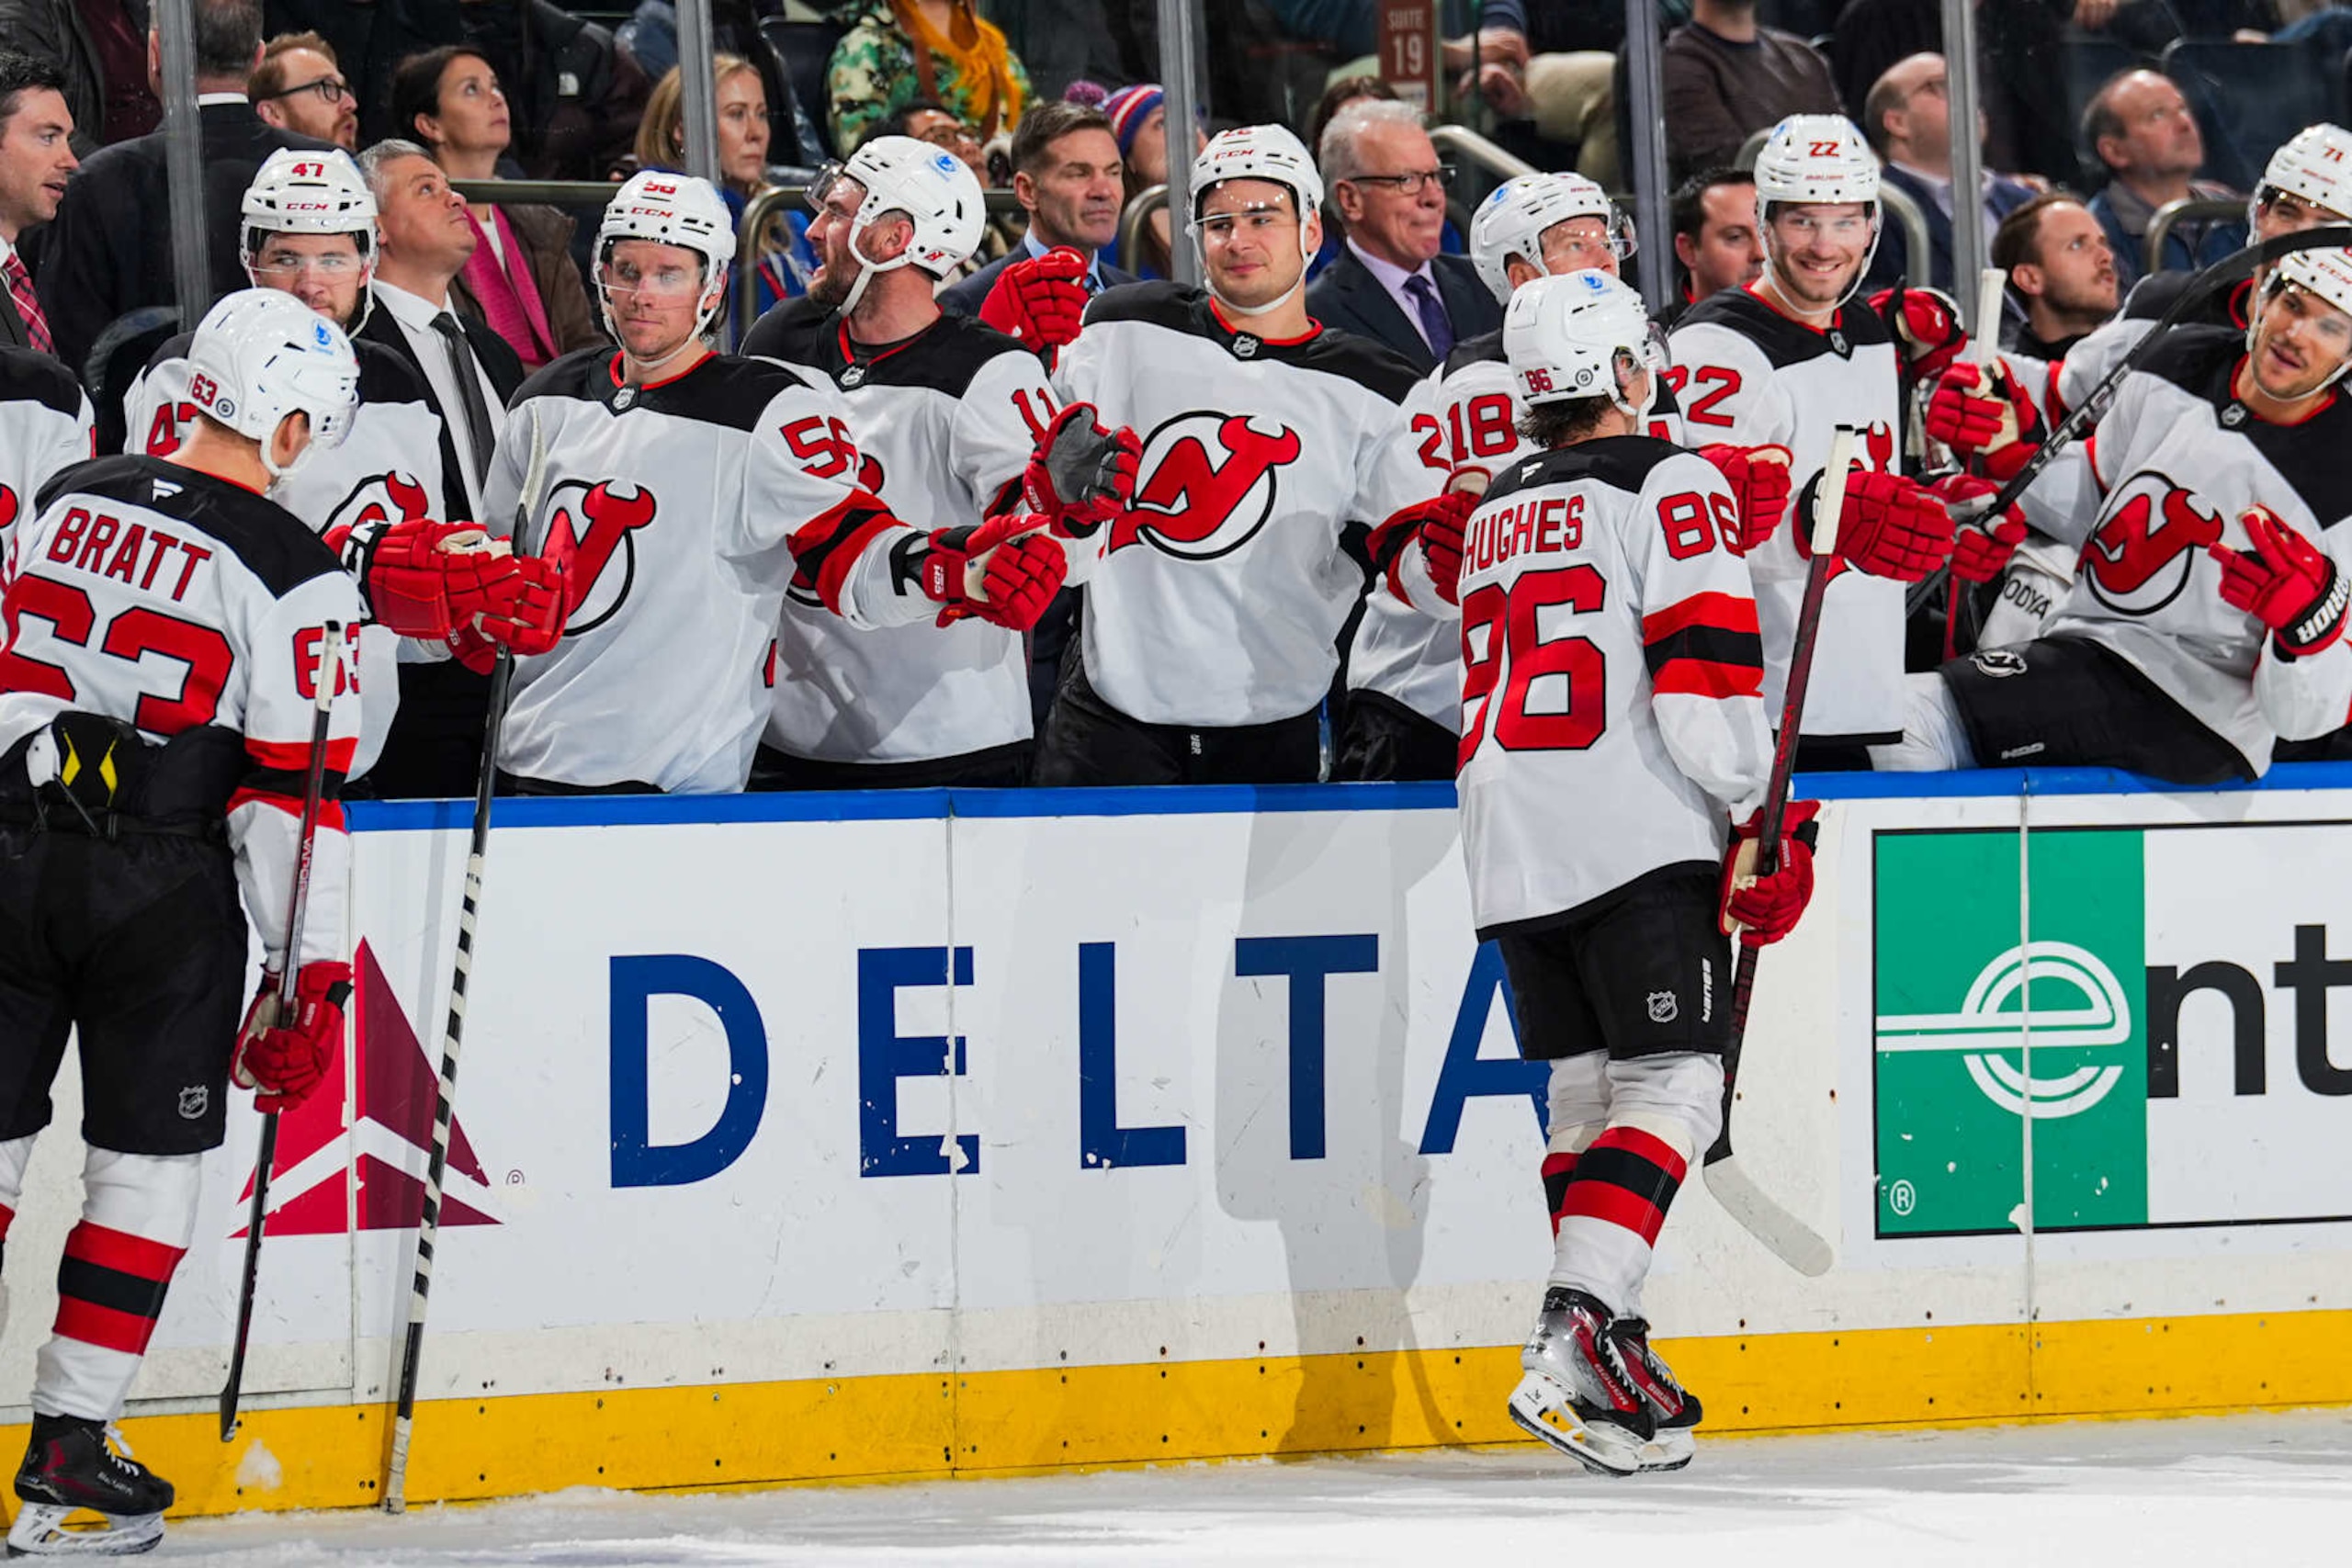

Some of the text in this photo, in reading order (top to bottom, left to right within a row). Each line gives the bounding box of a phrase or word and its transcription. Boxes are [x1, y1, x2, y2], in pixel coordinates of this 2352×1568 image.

[1393, 34, 1423, 74] 19
[291, 163, 324, 177] 47
[1807, 140, 1840, 158] 22
[630, 206, 673, 219] CCM
[191, 373, 218, 407] 63
[1525, 368, 1553, 392] 86
[1447, 392, 1519, 459] 18
[47, 506, 212, 603] BRATT
[1460, 494, 1584, 579] HUGHES
[1657, 491, 1746, 561] 86
[0, 570, 234, 737] 63
[1455, 562, 1607, 772] 86
[1702, 956, 1713, 1023] BAUER
[609, 933, 1552, 1189] DELTA
[1593, 1362, 1631, 1407] BAUER
